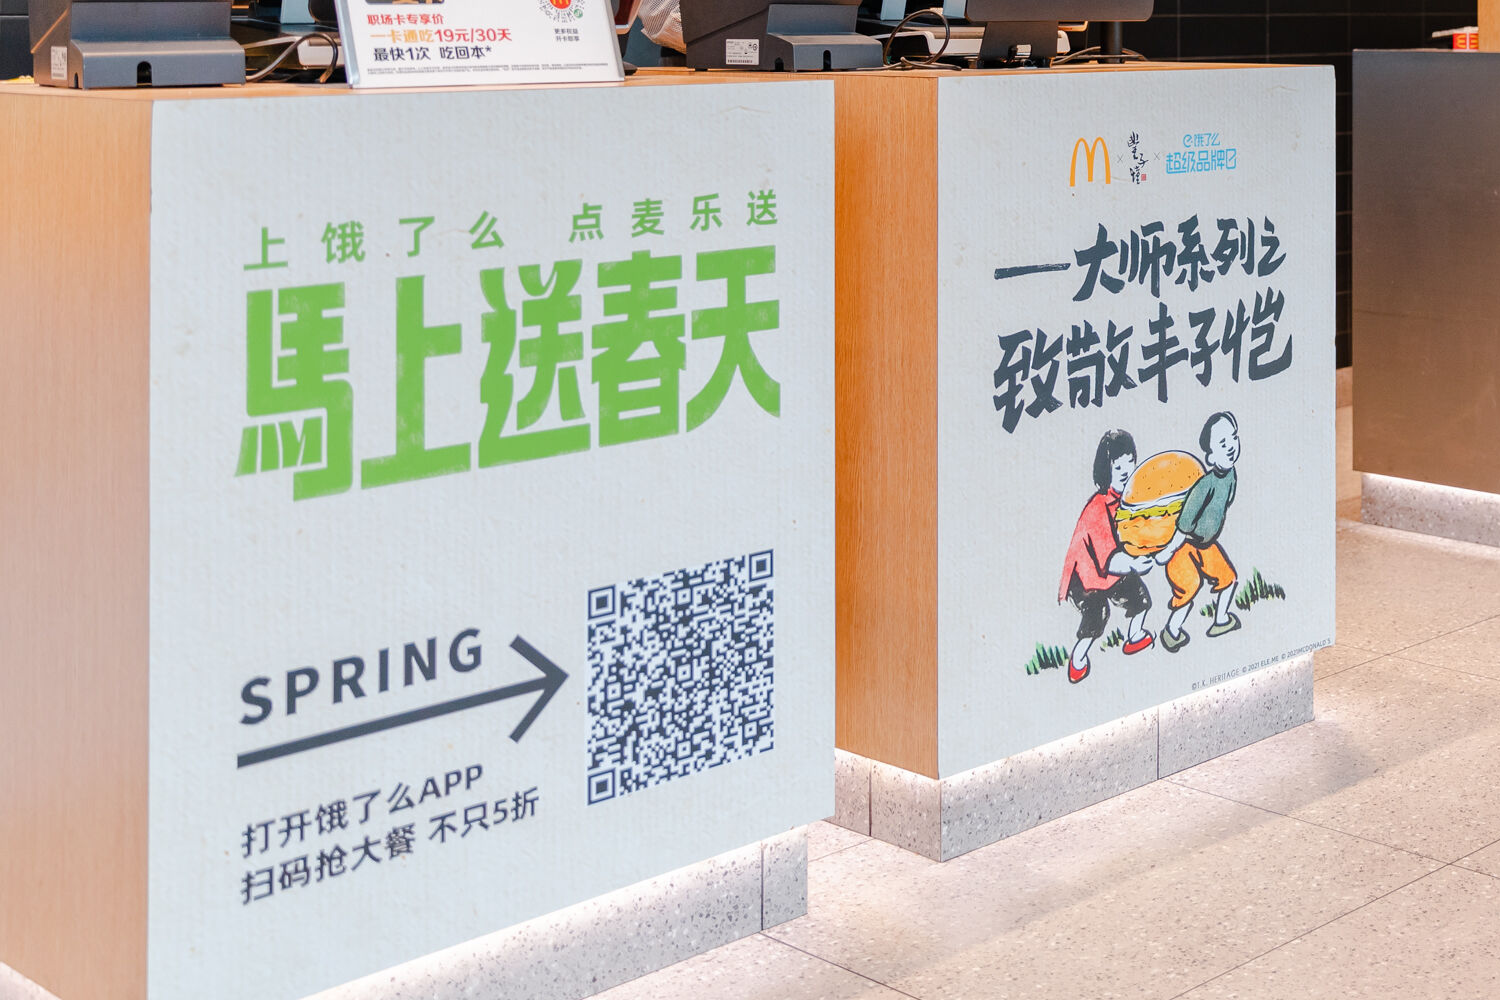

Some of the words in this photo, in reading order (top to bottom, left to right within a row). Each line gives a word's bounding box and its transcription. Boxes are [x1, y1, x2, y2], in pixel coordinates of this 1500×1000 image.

[367, 13, 444, 26] 职场卡专享价
[373, 46, 431, 62] 最快1次
[243, 211, 505, 271] 上饿了么
[568, 189, 778, 243] 点麦乐送
[239, 627, 483, 726] SPRING
[241, 764, 483, 859] 打开饿了么APP
[241, 824, 416, 905] 扫码抢大餐
[429, 787, 540, 846] 不只5折
